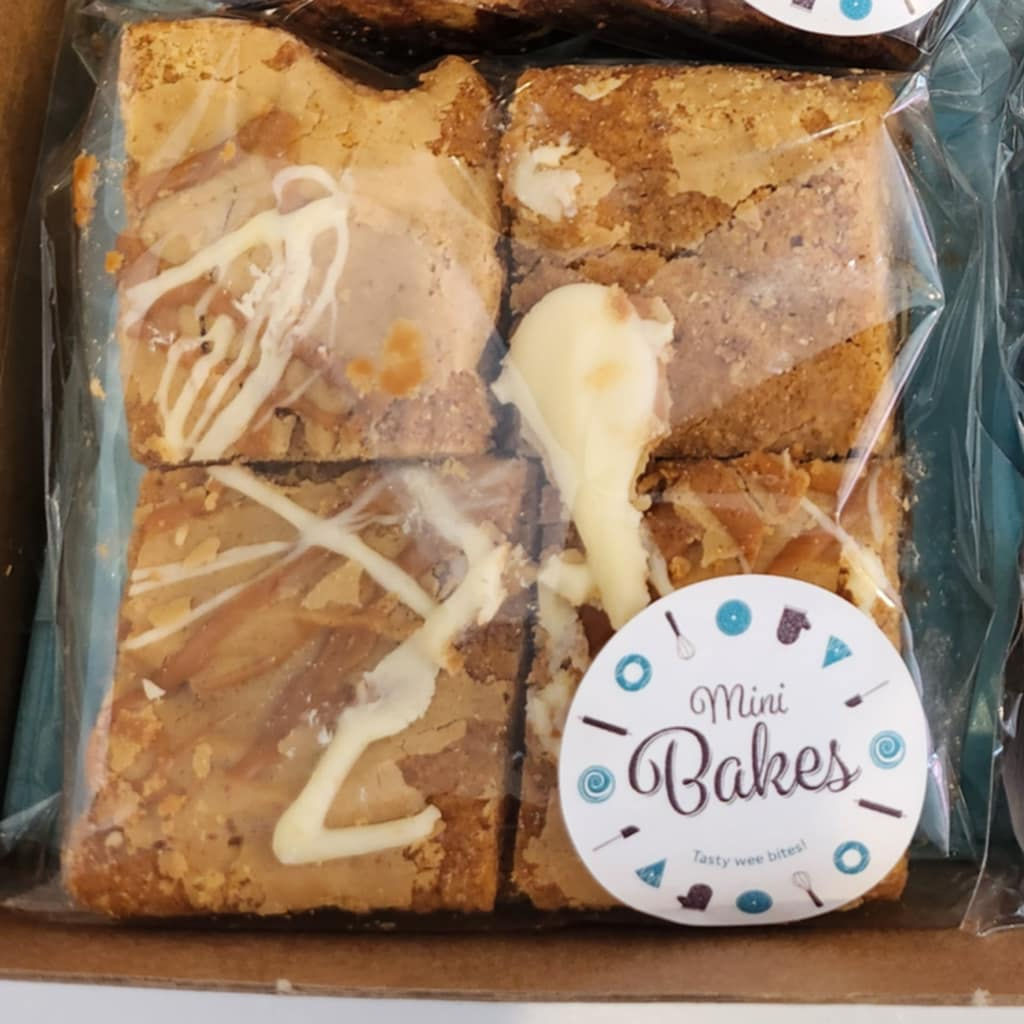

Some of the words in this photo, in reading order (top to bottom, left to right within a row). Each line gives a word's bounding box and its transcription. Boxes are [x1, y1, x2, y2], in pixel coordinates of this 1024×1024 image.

[689, 682, 789, 724] Mini
[628, 721, 862, 817] Bakes
[692, 849, 732, 869] Tasty
[734, 854, 764, 867] wee
[767, 839, 808, 863] bites!
